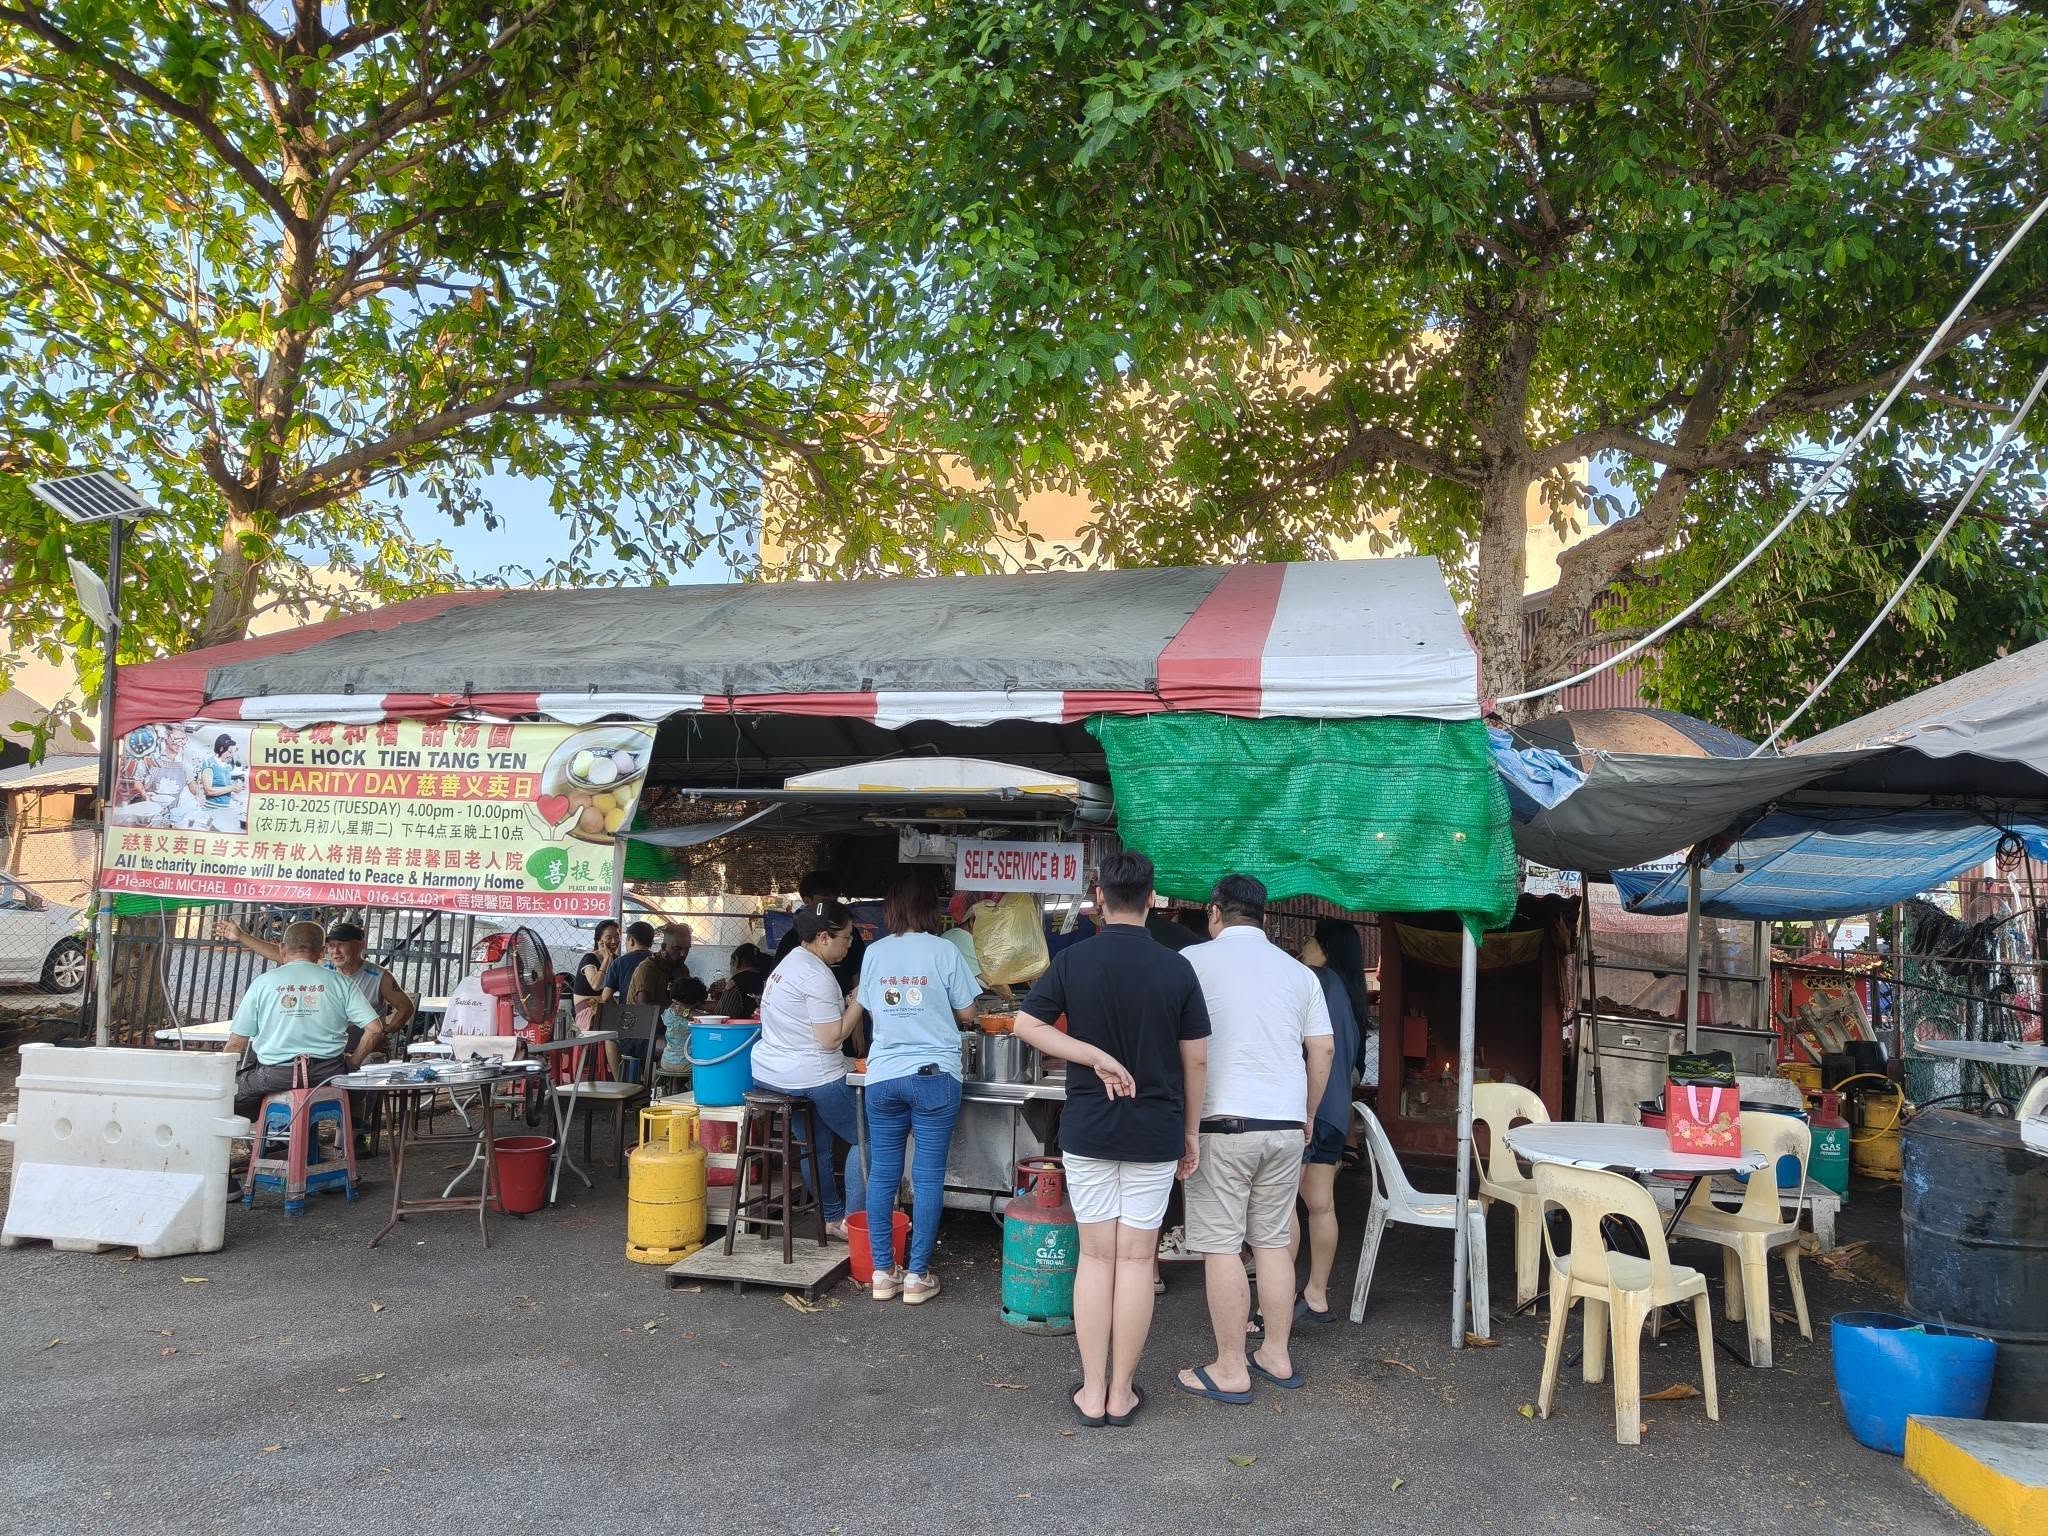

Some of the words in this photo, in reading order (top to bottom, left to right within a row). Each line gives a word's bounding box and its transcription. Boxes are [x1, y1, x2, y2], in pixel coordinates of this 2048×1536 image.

[265, 748, 304, 764] HOE
[311, 749, 365, 766] HOCK
[378, 750, 421, 768] TIEN
[428, 751, 479, 769] TANG
[487, 752, 527, 770] YEN
[254, 769, 362, 793] CHARITY
[365, 773, 412, 796] DAY
[416, 774, 533, 799] 慈善义卖日
[258, 798, 331, 813] 28-10-2025
[333, 800, 400, 817] (TUESDAY)
[406, 803, 454, 820] 4.00pm
[466, 804, 523, 822] 10.00pm
[256, 816, 393, 838] (农历九月初八,星期二)
[401, 822, 524, 841] 下午4点至晚上10点
[121, 833, 523, 871] 慈善义卖日当天所有收入将捐给菩提馨园老人院
[115, 853, 137, 868] All
[141, 857, 154, 869] the
[156, 857, 198, 875] charity
[200, 859, 246, 876] income
[251, 863, 273, 878] will
[277, 864, 292, 879] be
[296, 866, 345, 882] donated
[348, 868, 361, 882] to
[365, 868, 404, 884] Peace
[408, 870, 418, 885] &
[423, 872, 480, 891] Harmony
[484, 874, 524, 890] Home
[964, 849, 1048, 881] SELF-SERVICE
[1050, 853, 1077, 881] 自助
[1558, 872, 1581, 882] VIS
[115, 874, 152, 888] Please
[153, 877, 174, 890] Call:
[175, 879, 227, 895] MICHAEL
[233, 882, 256, 896] 016
[258, 883, 282, 897] 477
[283, 884, 312, 898] 7764
[328, 887, 361, 902] ANNA
[367, 890, 389, 903] 016
[392, 891, 414, 904] 454
[417, 892, 446, 906] 4031
[516, 896, 550, 911] 院长:
[553, 897, 579, 911] 010
[581, 898, 606, 912] 396
[1820, 1143, 1841, 1151] GAS
[1036, 1248, 1066, 1259] GAS
